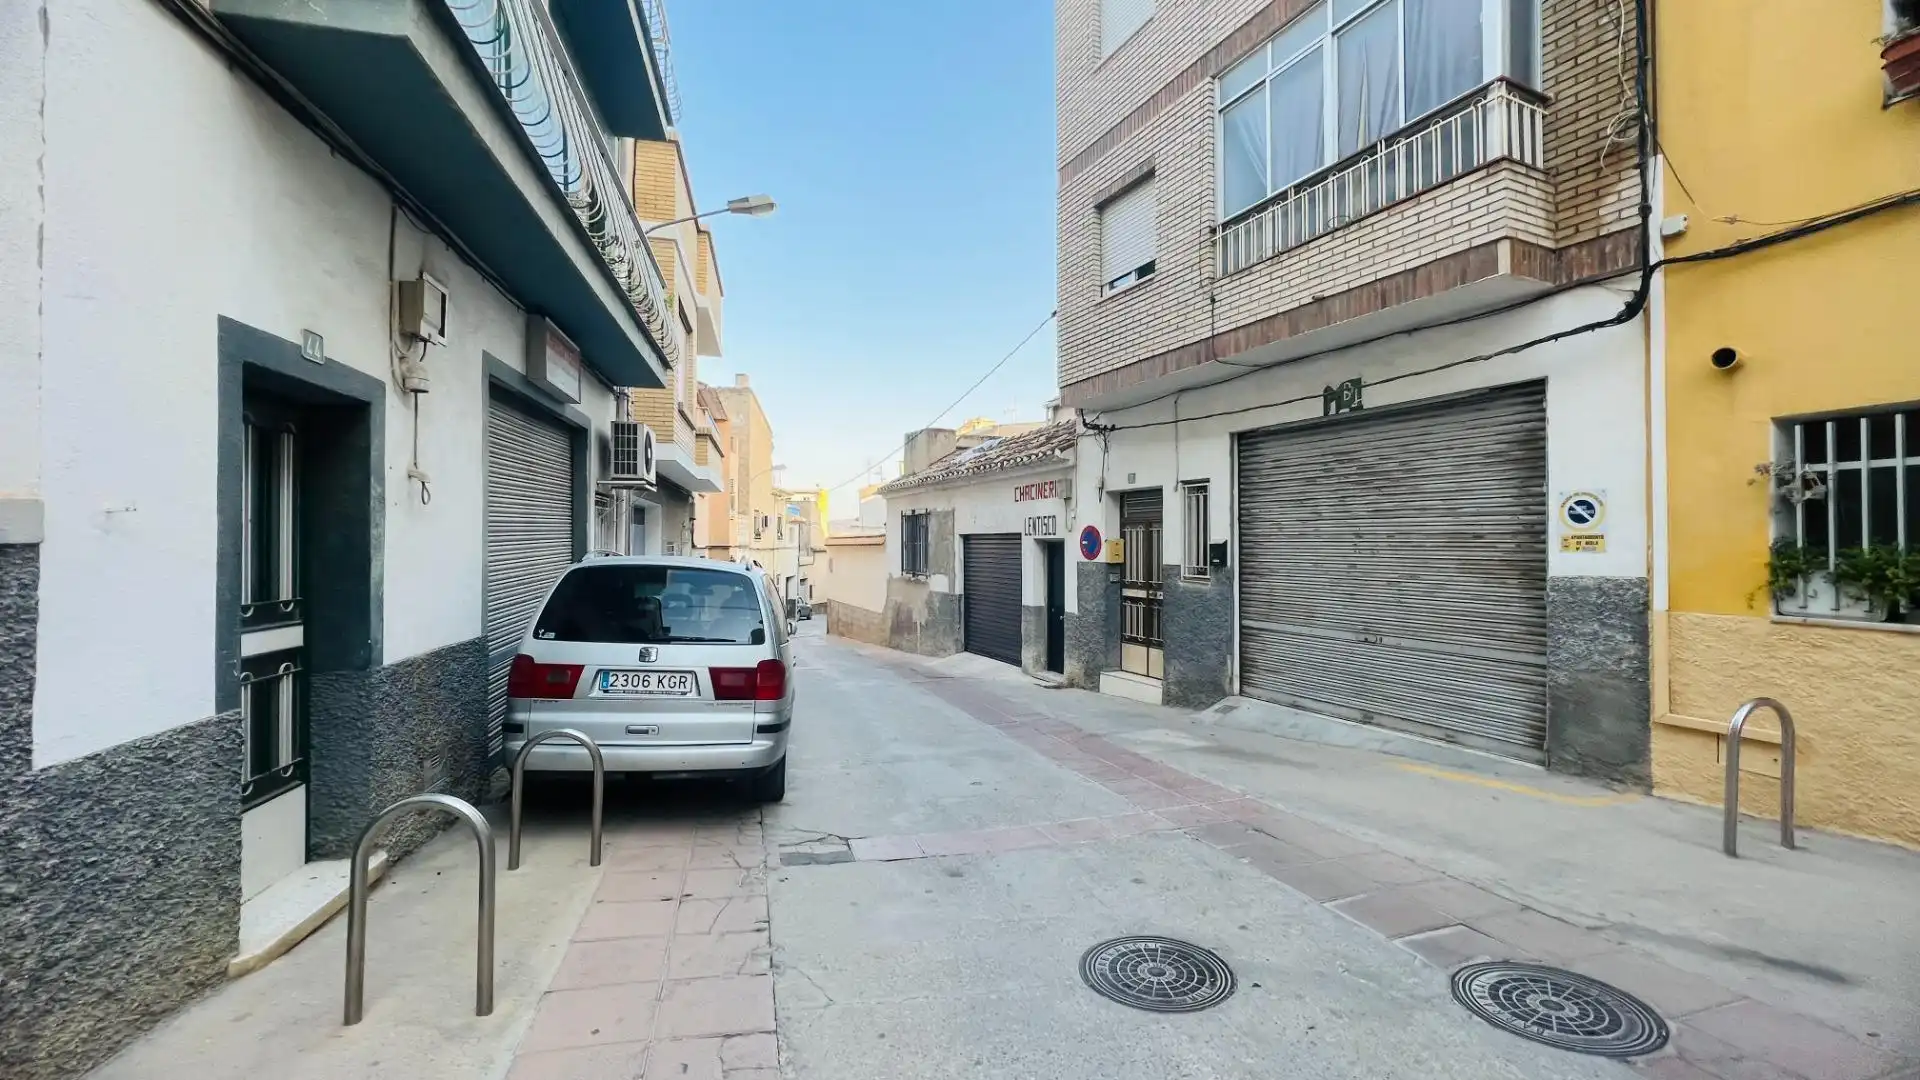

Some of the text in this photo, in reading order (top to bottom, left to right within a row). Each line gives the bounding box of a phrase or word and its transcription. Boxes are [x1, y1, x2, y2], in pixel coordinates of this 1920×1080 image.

[306, 335, 321, 358] 44
[1014, 480, 1058, 502] CHACINERI
[1024, 515, 1056, 536] LENTISCO
[609, 673, 688, 689] 2306 KGR
